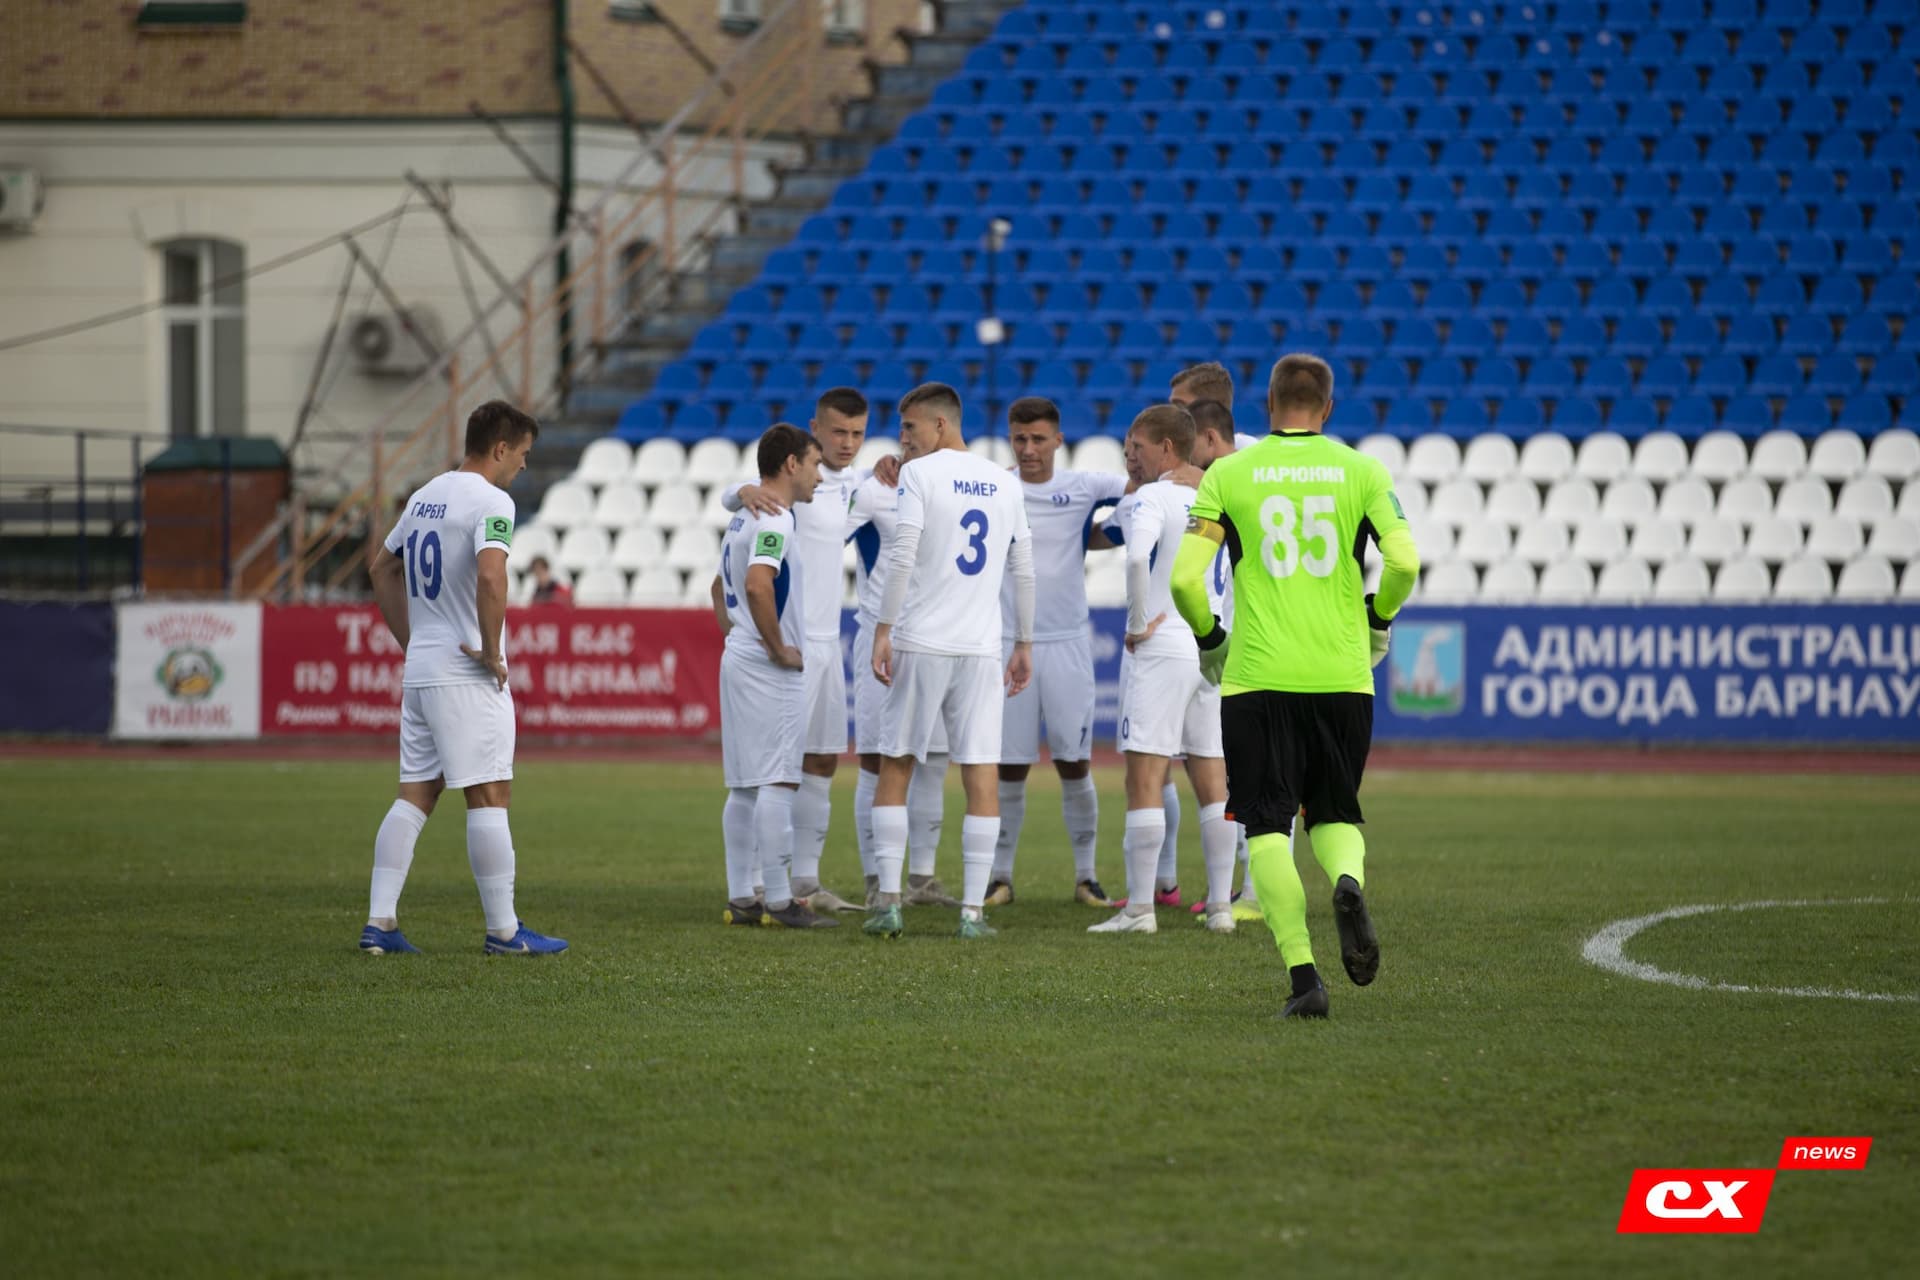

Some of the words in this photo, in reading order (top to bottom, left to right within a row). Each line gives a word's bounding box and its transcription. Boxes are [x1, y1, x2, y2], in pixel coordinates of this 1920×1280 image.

[410, 501, 447, 519] ГАРБУЗ
[953, 480, 998, 497] МАЙЕР
[406, 528, 442, 601] 19
[955, 508, 990, 576] 3
[1258, 494, 1340, 579] 85
[1481, 674, 1699, 726] ГОРОДА
[1715, 674, 1920, 718] БАРНАУ
